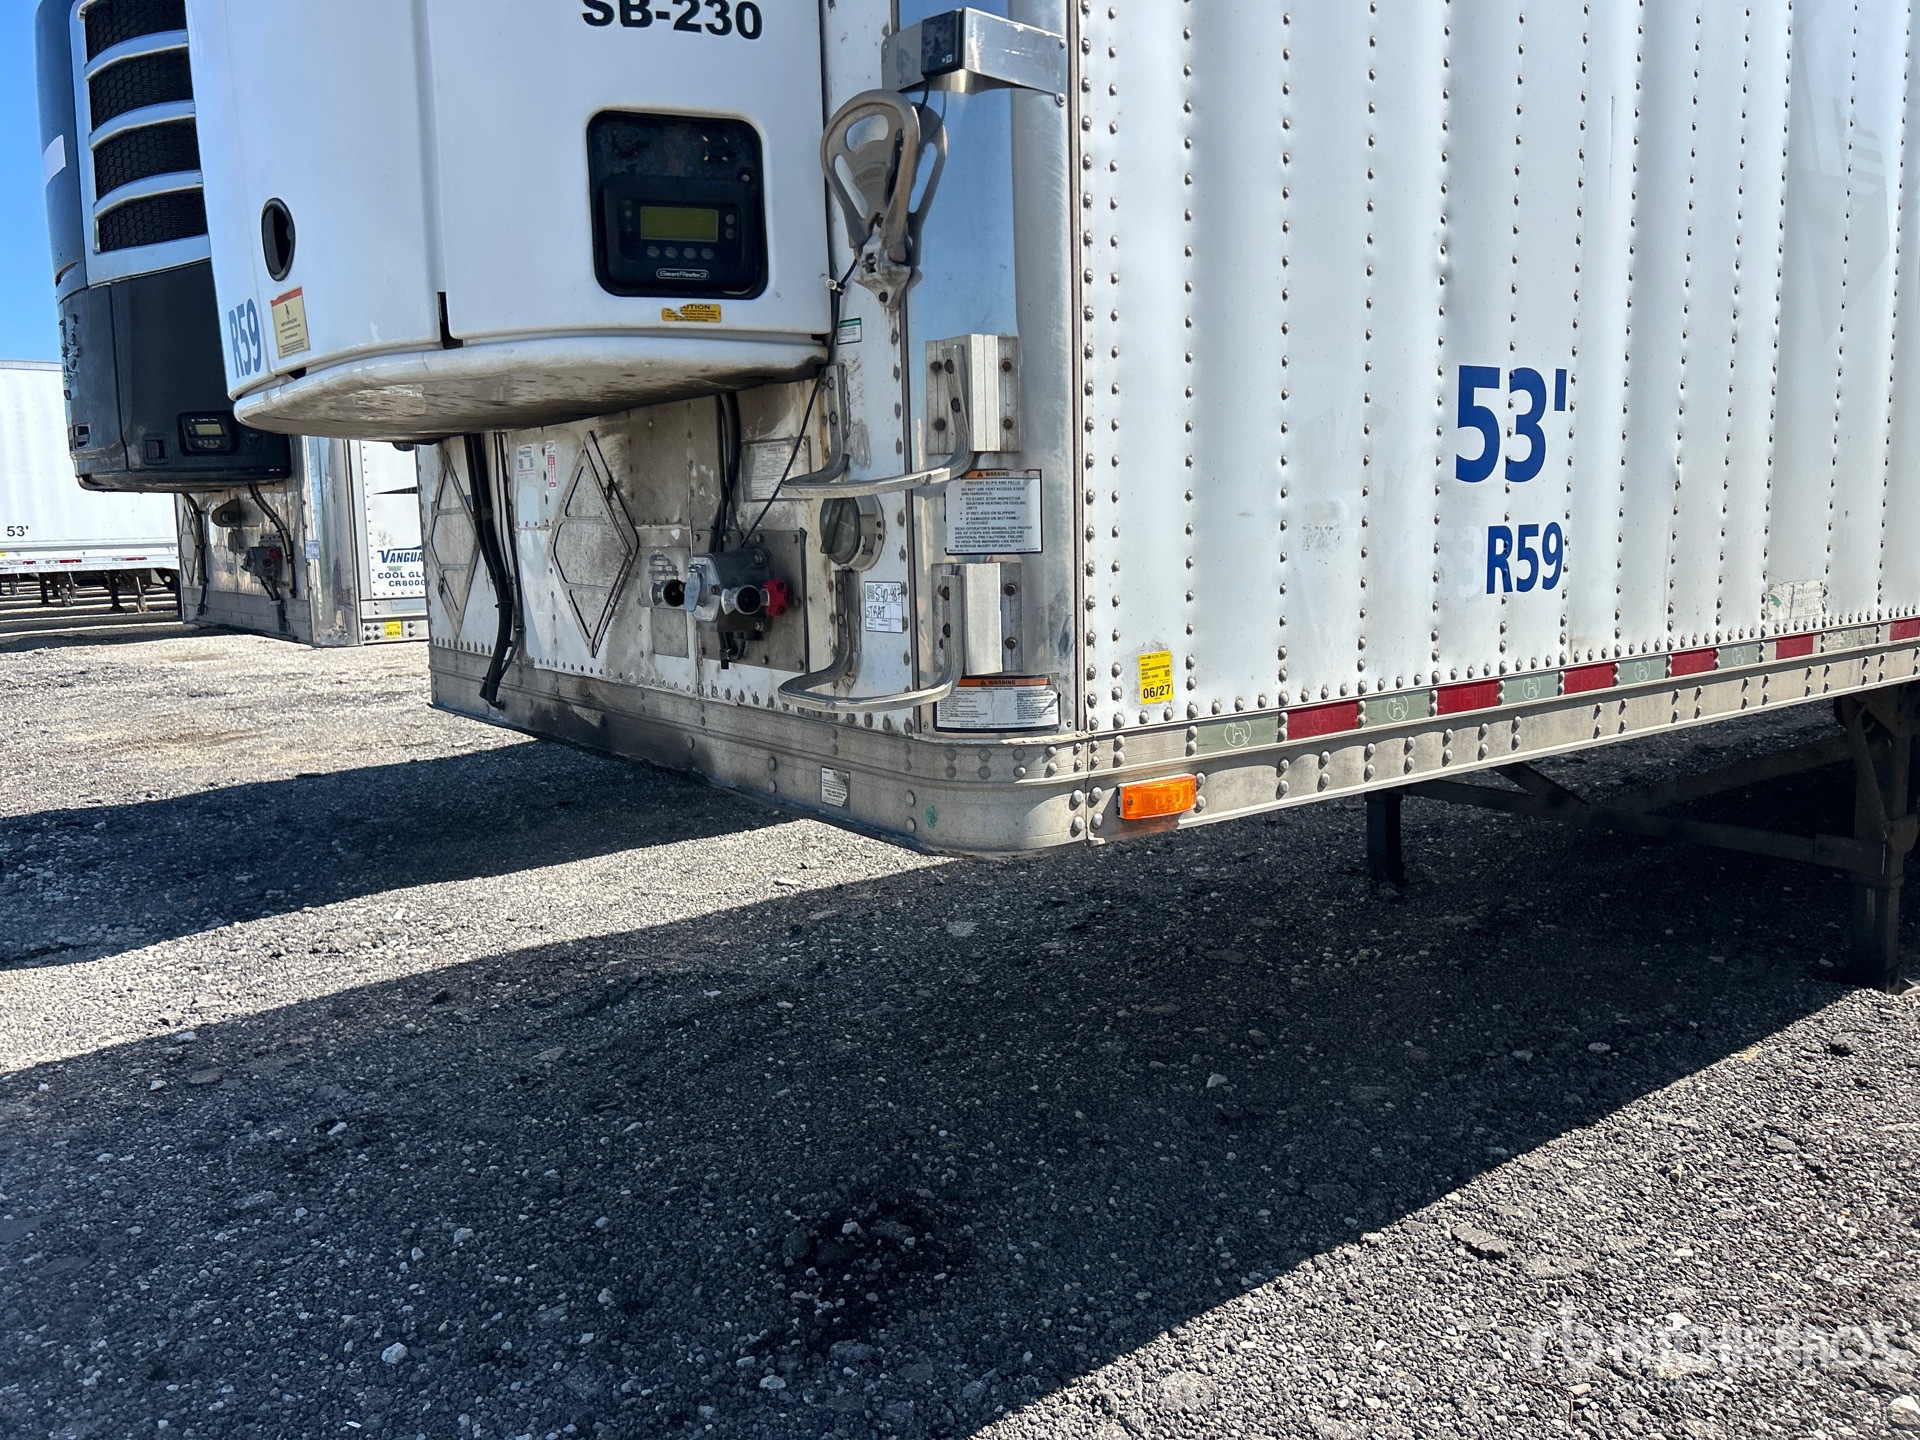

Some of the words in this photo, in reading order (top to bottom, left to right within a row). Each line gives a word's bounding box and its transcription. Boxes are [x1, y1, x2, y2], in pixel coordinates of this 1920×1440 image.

[582, 0, 763, 40] SB-230
[228, 298, 262, 379] R59
[1456, 365, 1567, 483] 53'
[6, 525, 29, 537] 53'
[1486, 522, 1563, 594] R59
[1143, 684, 1170, 699] 06/27
